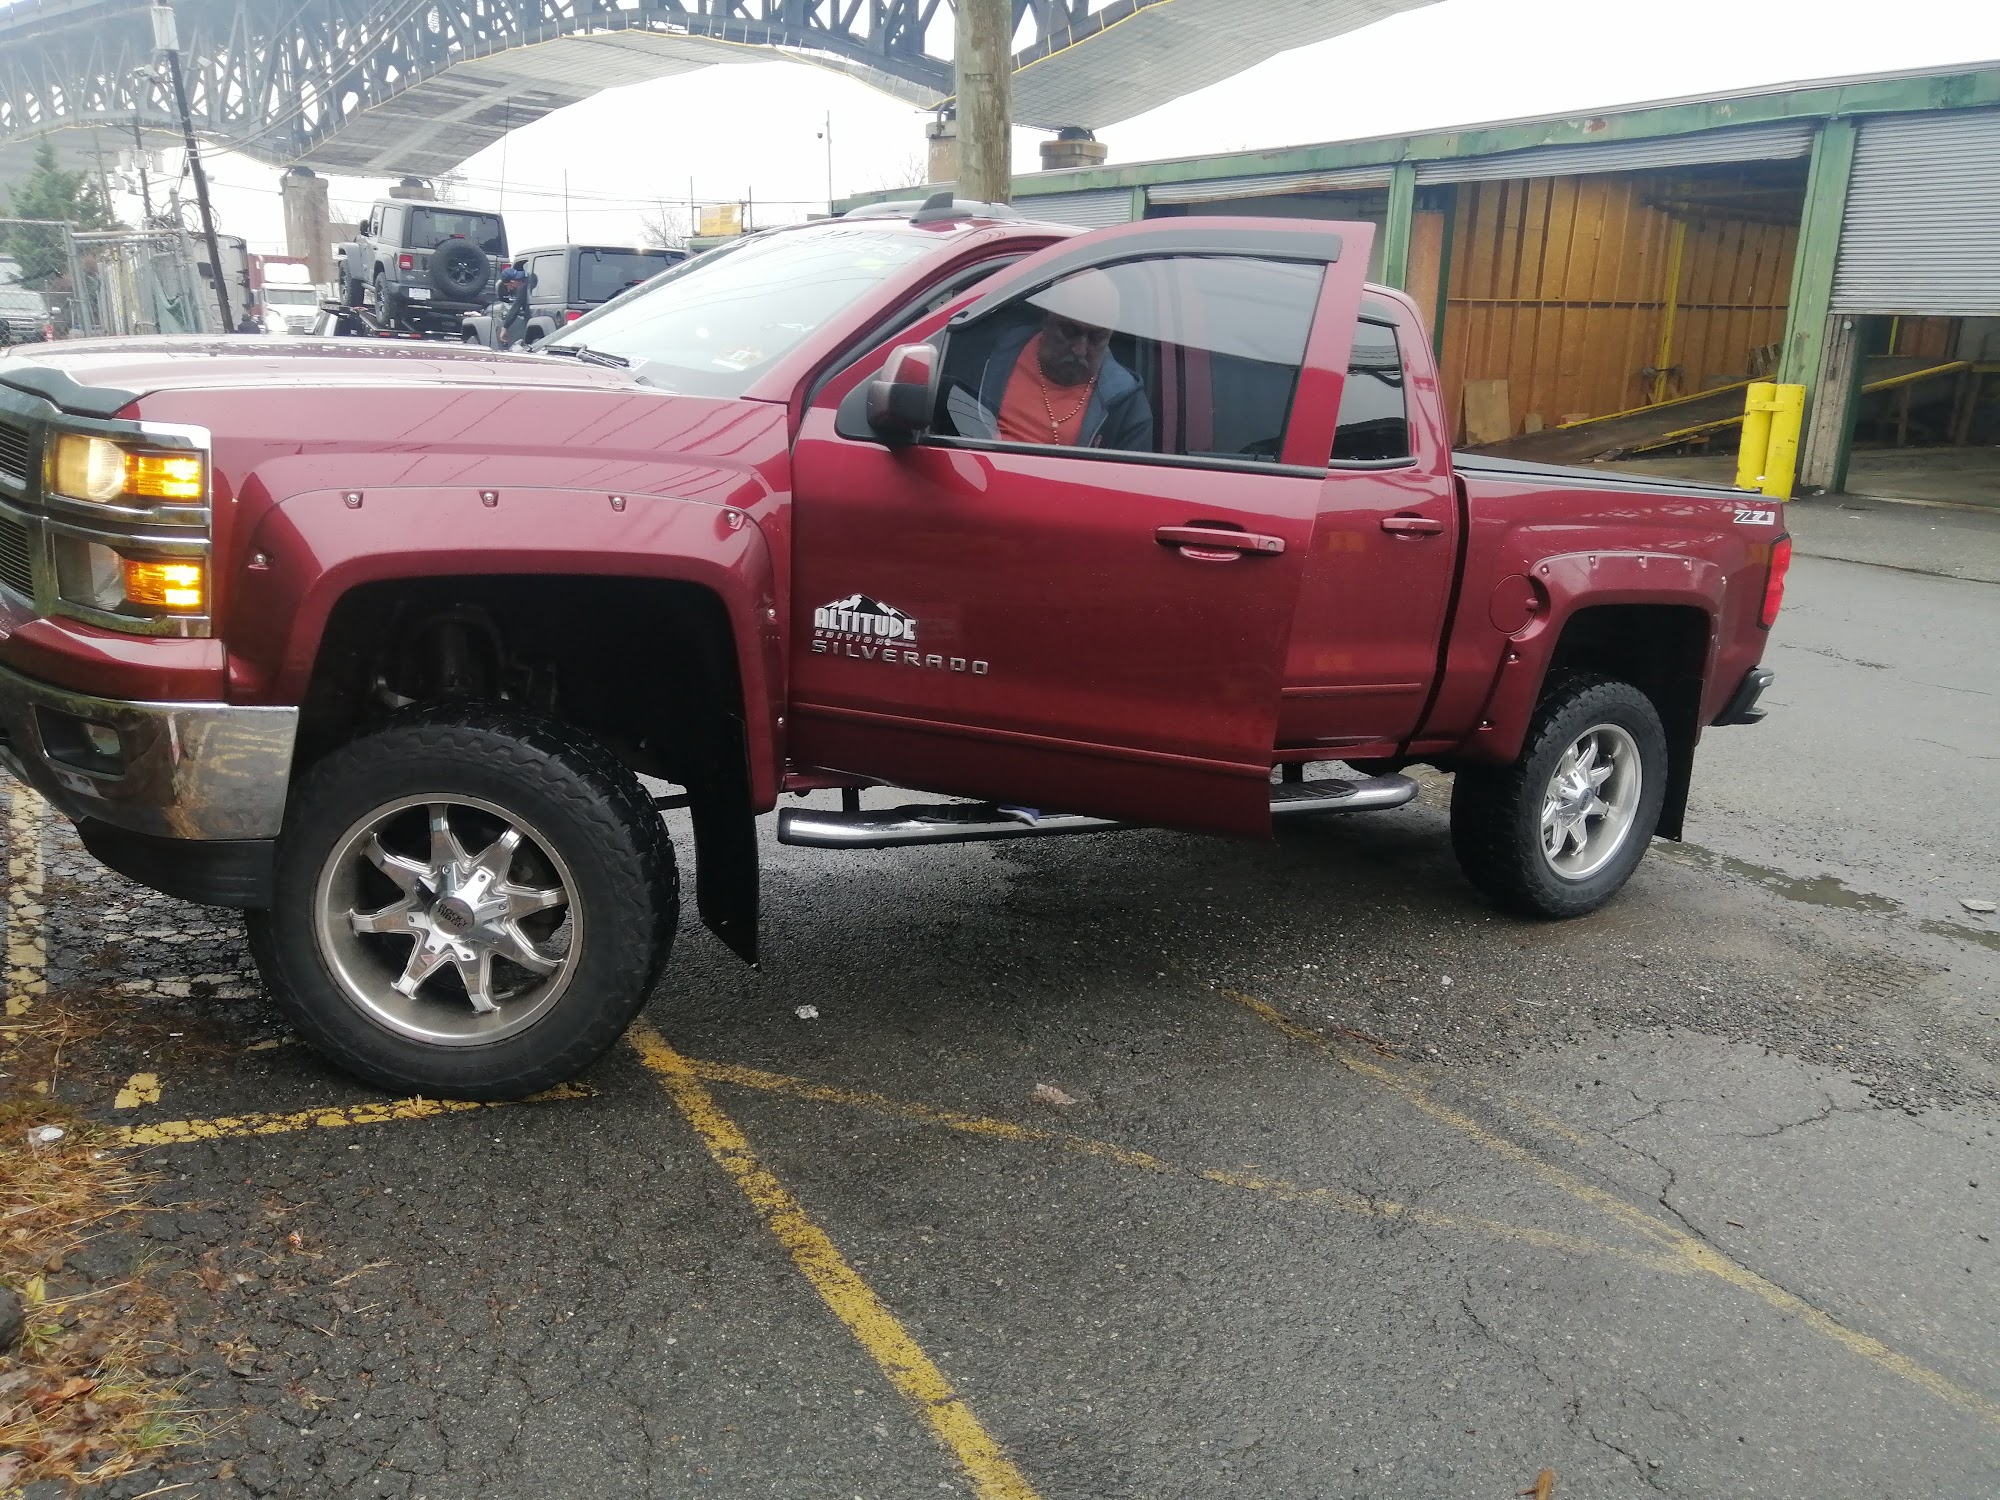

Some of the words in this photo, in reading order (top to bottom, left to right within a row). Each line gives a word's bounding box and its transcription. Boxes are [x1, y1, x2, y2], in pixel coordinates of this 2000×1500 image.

[1733, 509, 1776, 526] Z71
[814, 607, 917, 641] ALTITUDE
[812, 640, 989, 675] SILVERADO
